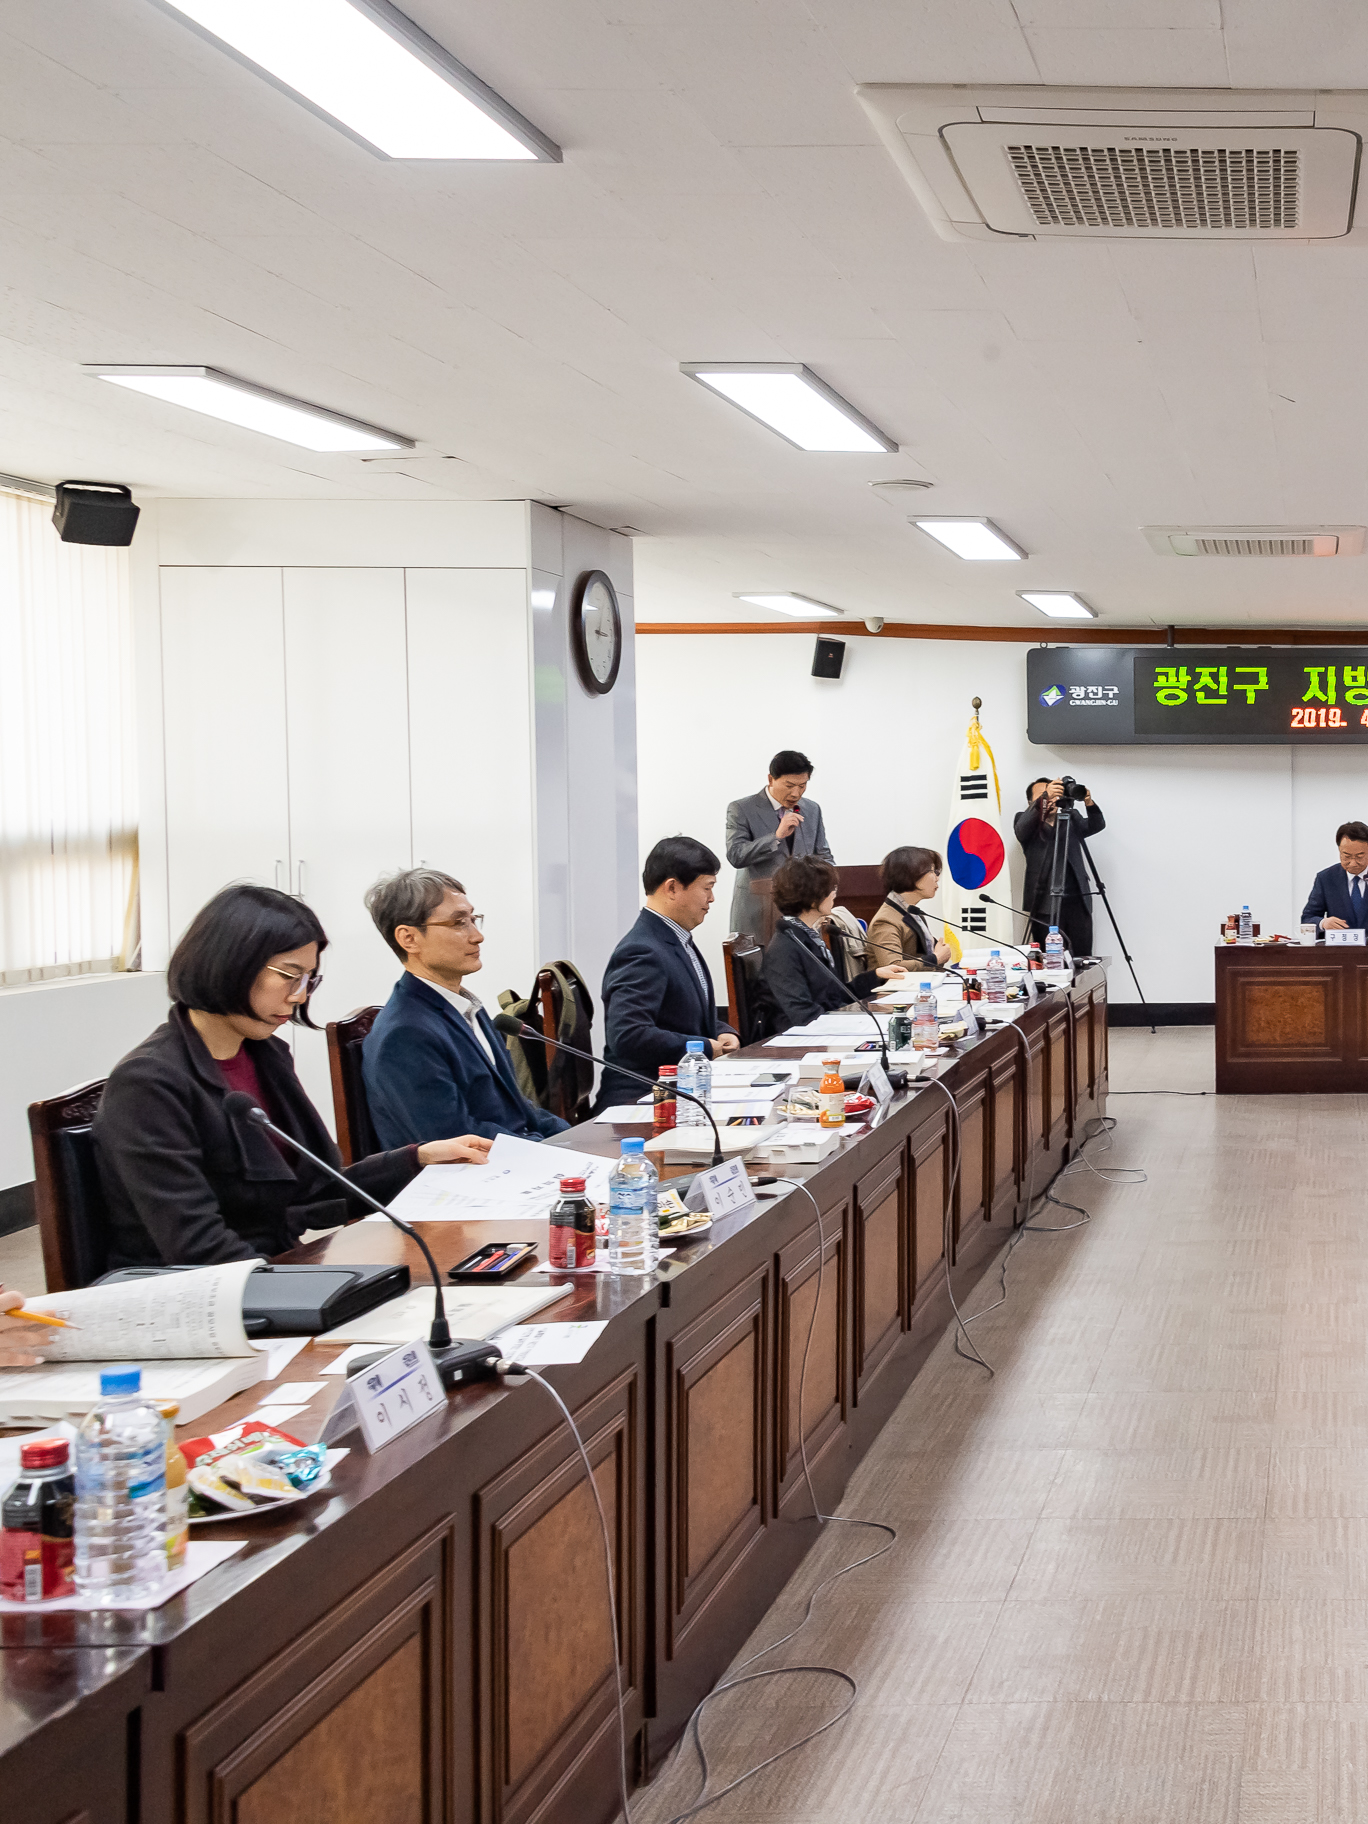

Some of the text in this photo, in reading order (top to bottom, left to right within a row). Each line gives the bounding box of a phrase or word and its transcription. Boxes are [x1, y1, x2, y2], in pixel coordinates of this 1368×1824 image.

[1069, 686, 1120, 699] 광진구
[1153, 665, 1269, 706] 광진구
[1290, 707, 1347, 728] 2019.
